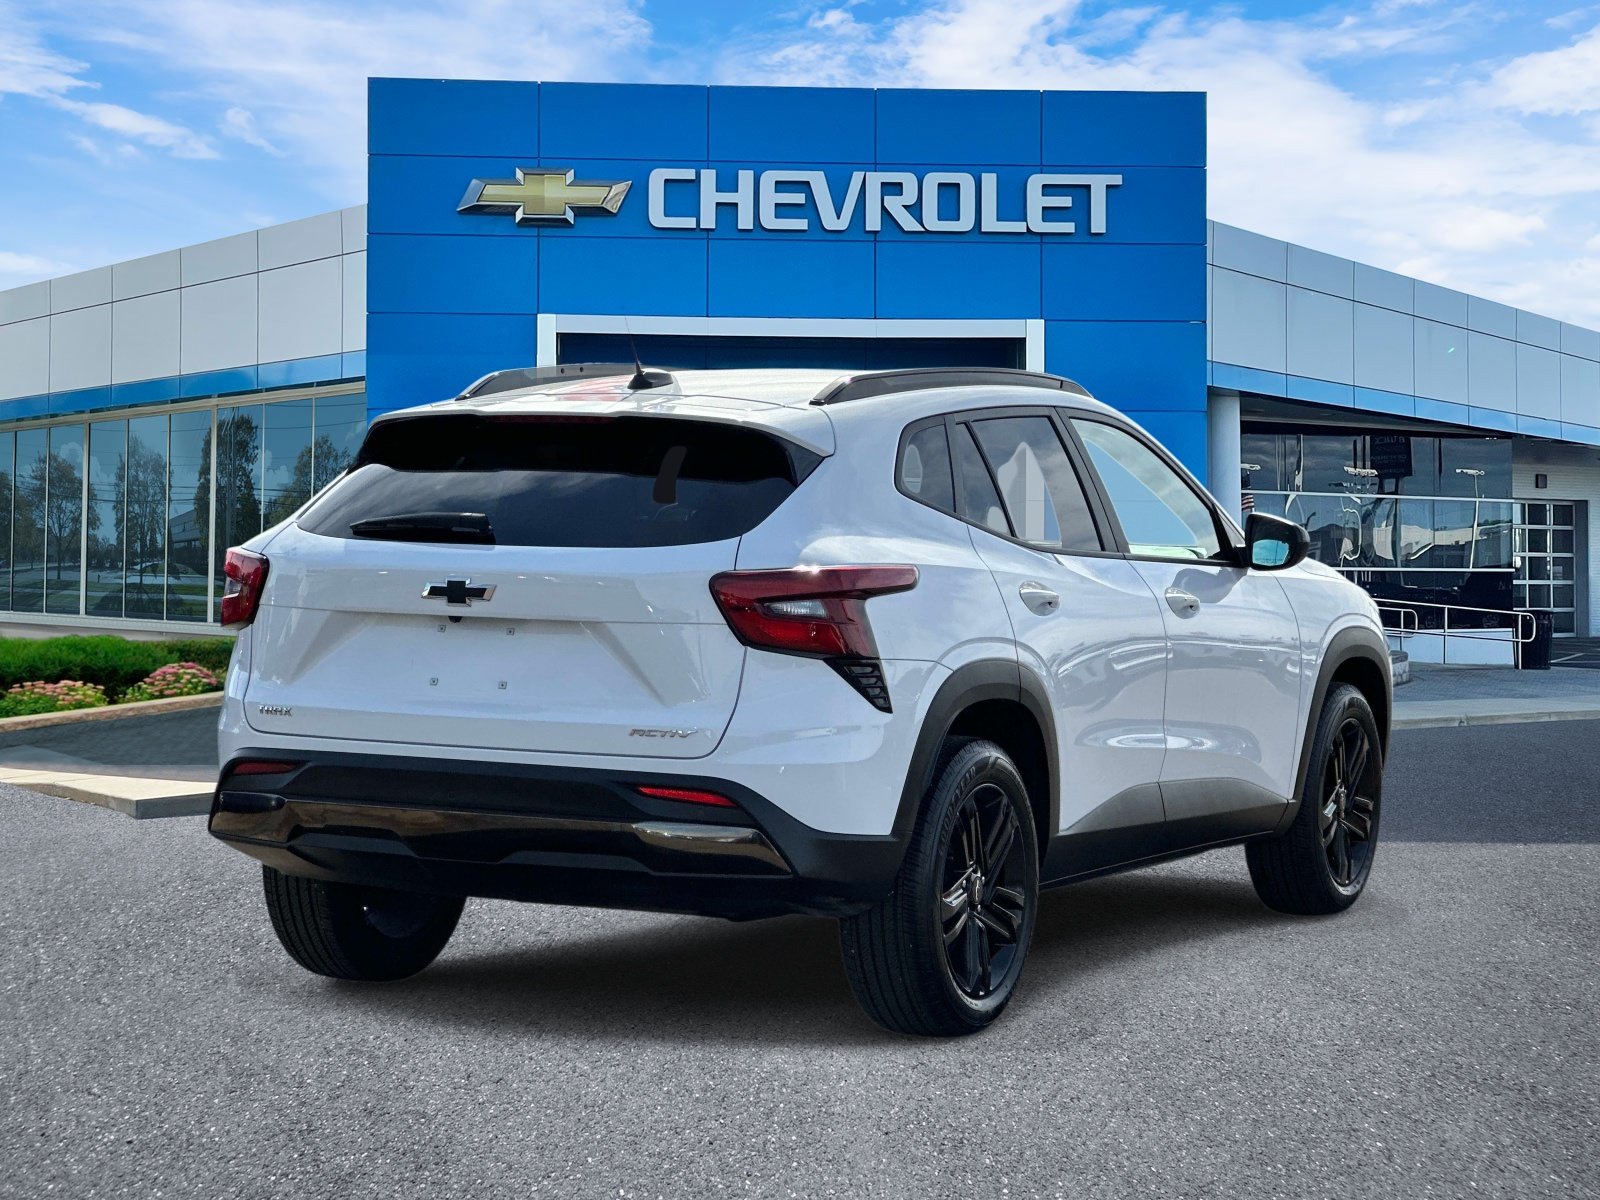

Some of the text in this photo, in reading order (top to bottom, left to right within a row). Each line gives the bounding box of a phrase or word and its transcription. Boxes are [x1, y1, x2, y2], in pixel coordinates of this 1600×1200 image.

[648, 167, 1123, 234] CHEVROLET
[259, 705, 293, 717] TRAX
[628, 727, 699, 739] ACTIV
